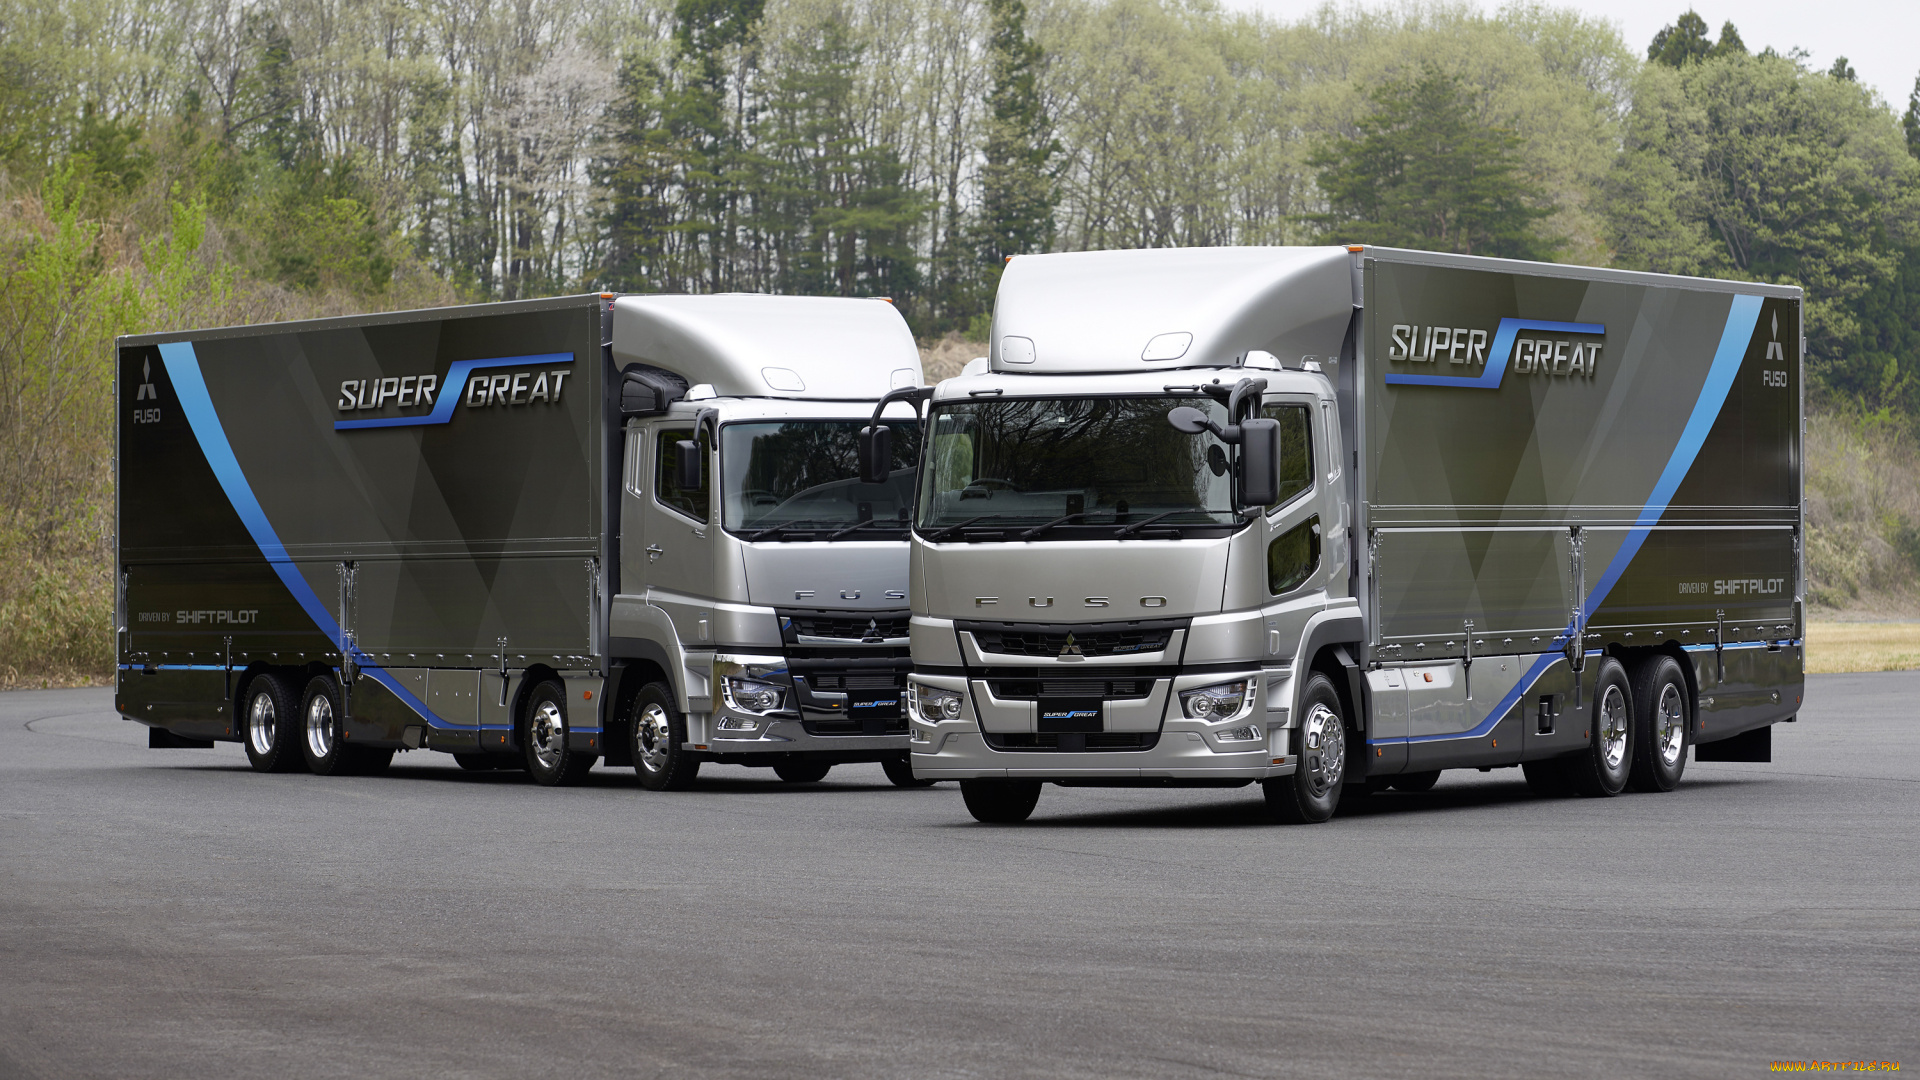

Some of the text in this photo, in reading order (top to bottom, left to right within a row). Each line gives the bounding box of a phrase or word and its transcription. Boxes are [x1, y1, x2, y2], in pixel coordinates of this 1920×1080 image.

[1389, 324, 1603, 378] SUPER GREAT
[1763, 370, 1787, 387] FUSO
[337, 370, 571, 411] SUPER GREAT
[133, 408, 161, 424] FUSO
[795, 589, 905, 600] FUS
[1678, 578, 1784, 595] DRIVEN BY SHIFTPILOT
[975, 596, 1167, 608] FUSO
[138, 609, 259, 624] DRIVEN BY SHIFTPILOT
